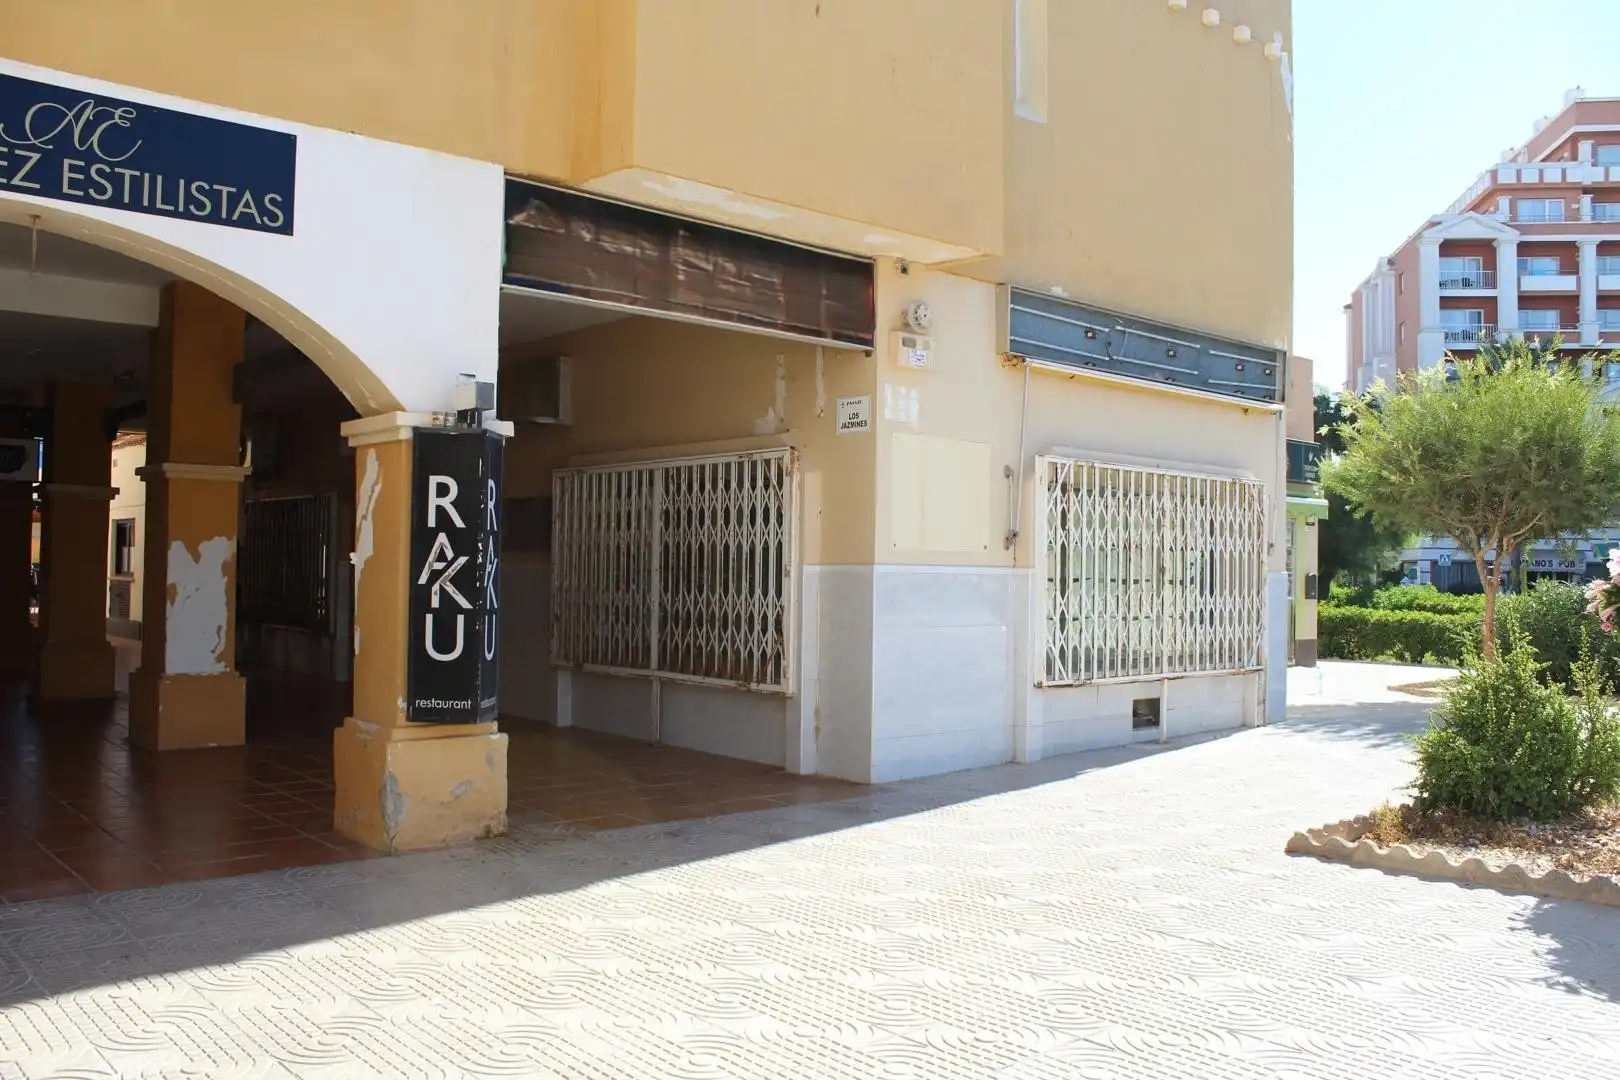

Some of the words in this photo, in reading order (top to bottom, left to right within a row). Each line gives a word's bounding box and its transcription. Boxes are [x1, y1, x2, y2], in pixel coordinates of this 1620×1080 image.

[0, 99, 142, 162] AE
[62, 158, 284, 228] ESTILISTAS
[840, 419, 868, 430] JAZMINES
[848, 412, 860, 421] LOS
[417, 474, 474, 662] RAKU
[484, 477, 498, 661] RAKU
[1558, 559, 1576, 568] PUB
[415, 697, 472, 709] restaurant
